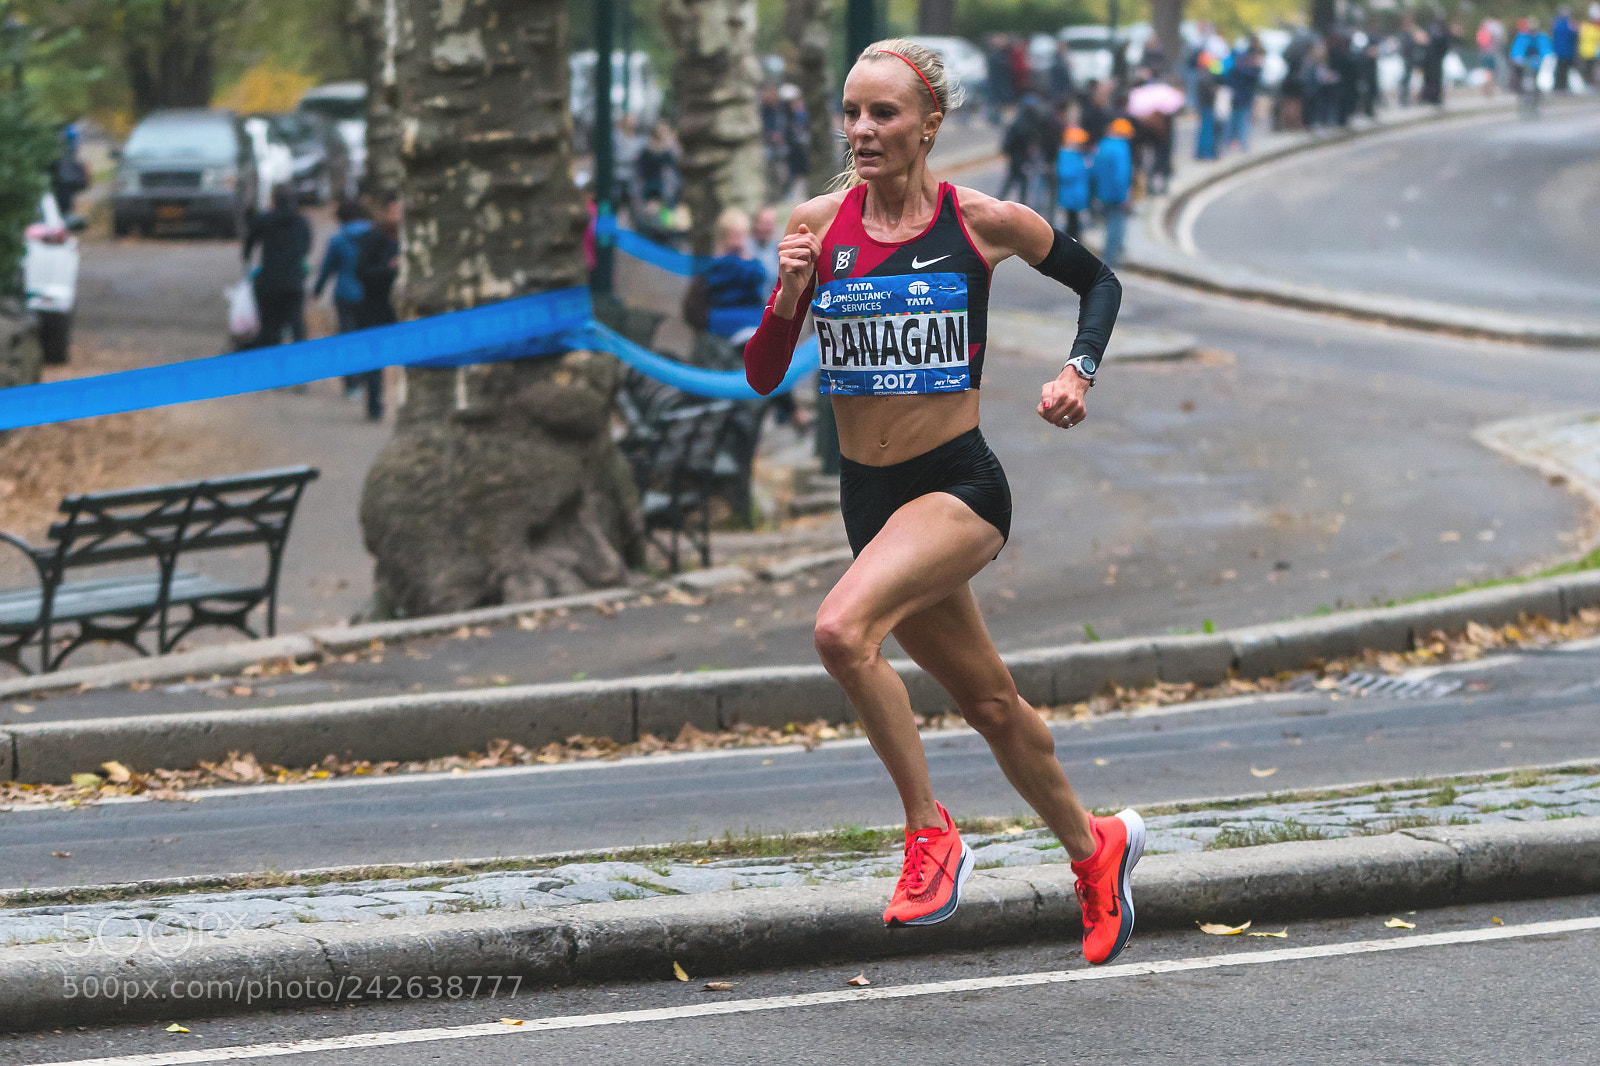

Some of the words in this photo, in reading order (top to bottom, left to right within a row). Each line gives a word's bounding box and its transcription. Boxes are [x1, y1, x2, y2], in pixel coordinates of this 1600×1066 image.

[846, 282, 874, 292] TATA
[832, 290, 892, 303] CONSULTANCY
[905, 297, 934, 306] TATA
[841, 302, 882, 313] SERVICES
[816, 316, 965, 366] FLANAGAN
[872, 373, 917, 390] 2017
